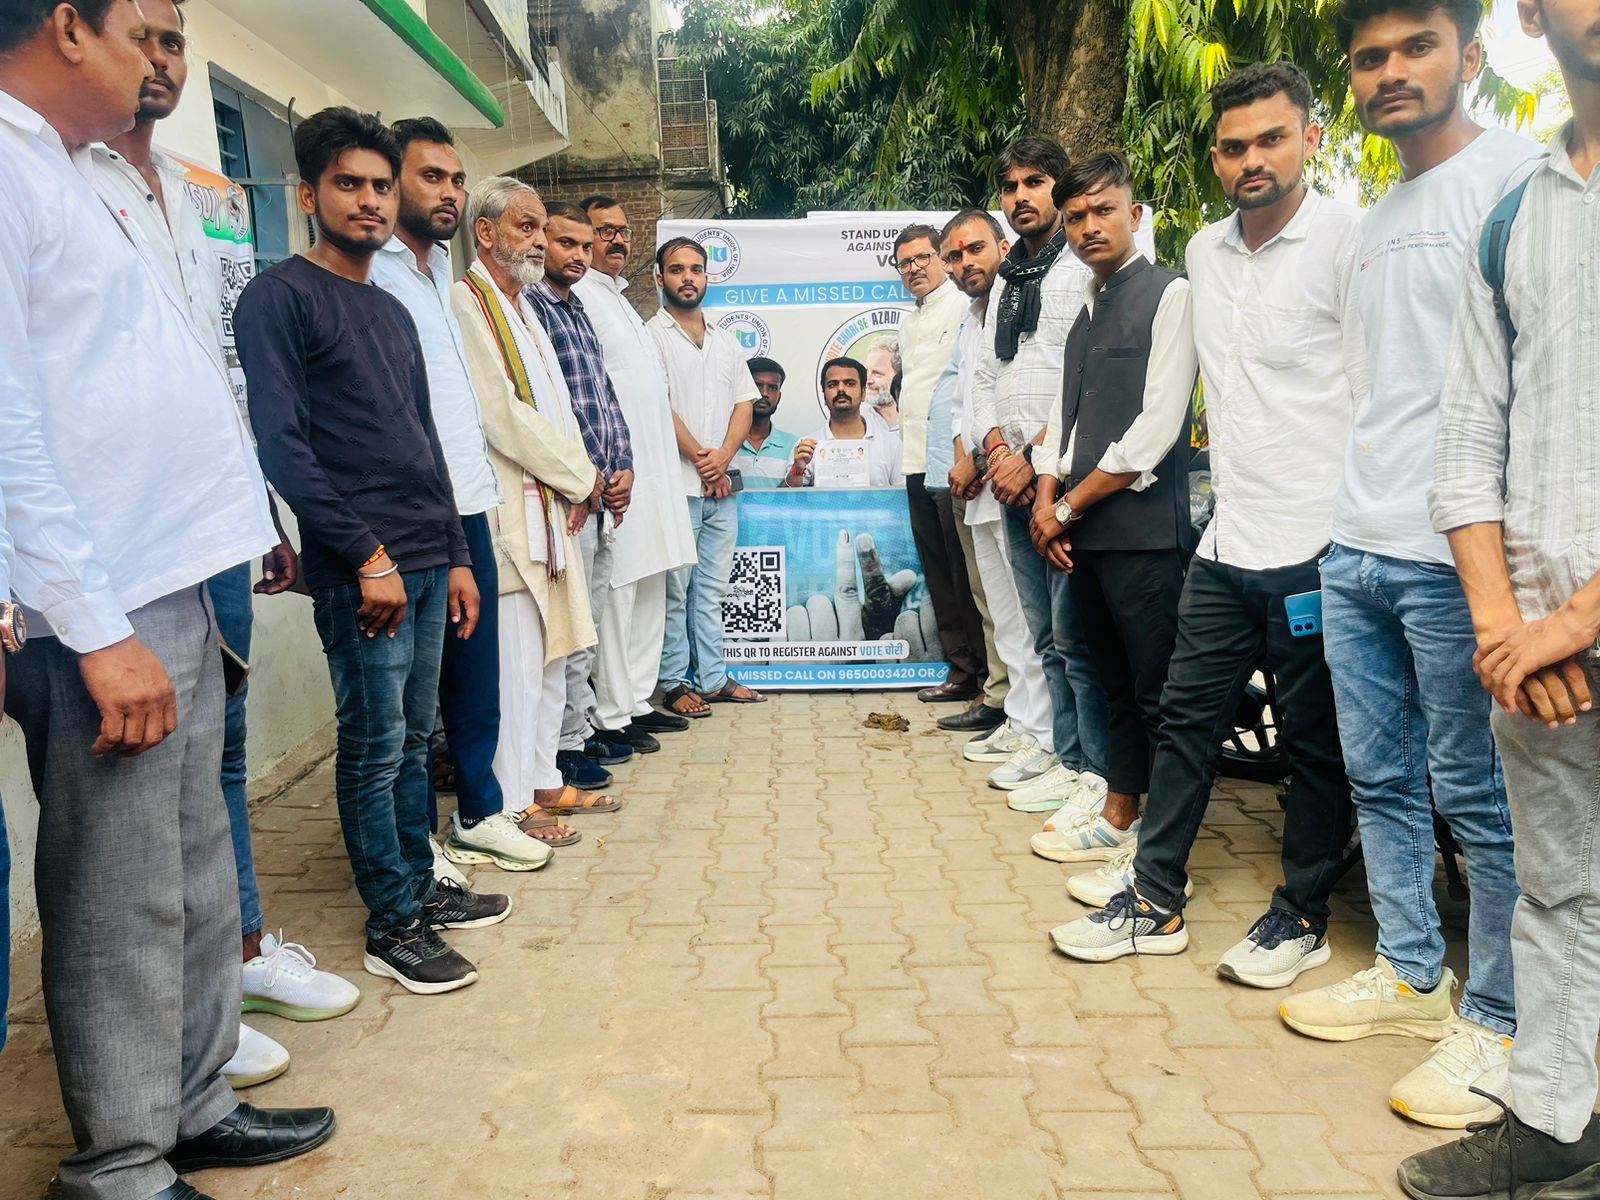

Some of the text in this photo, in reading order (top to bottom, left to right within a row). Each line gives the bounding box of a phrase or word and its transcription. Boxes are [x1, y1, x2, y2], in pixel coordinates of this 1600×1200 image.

[183, 180, 222, 231] SUI
[841, 228, 899, 240] STAND UP
[695, 230, 739, 278] UDENTS' UNION OF INDIA
[725, 288, 769, 304] GIVE
[775, 287, 788, 302] A
[794, 285, 865, 302] MISSED
[719, 313, 752, 330] TUDENTS'
[751, 317, 767, 338] UNION
[857, 317, 870, 331] SE
[871, 310, 901, 326] AZADI
[722, 642, 903, 659] THIS QR TO REGISTER AGAINST VOTE चोरी
[727, 667, 936, 681] A MISSED CALL ON 9650003420 OR
